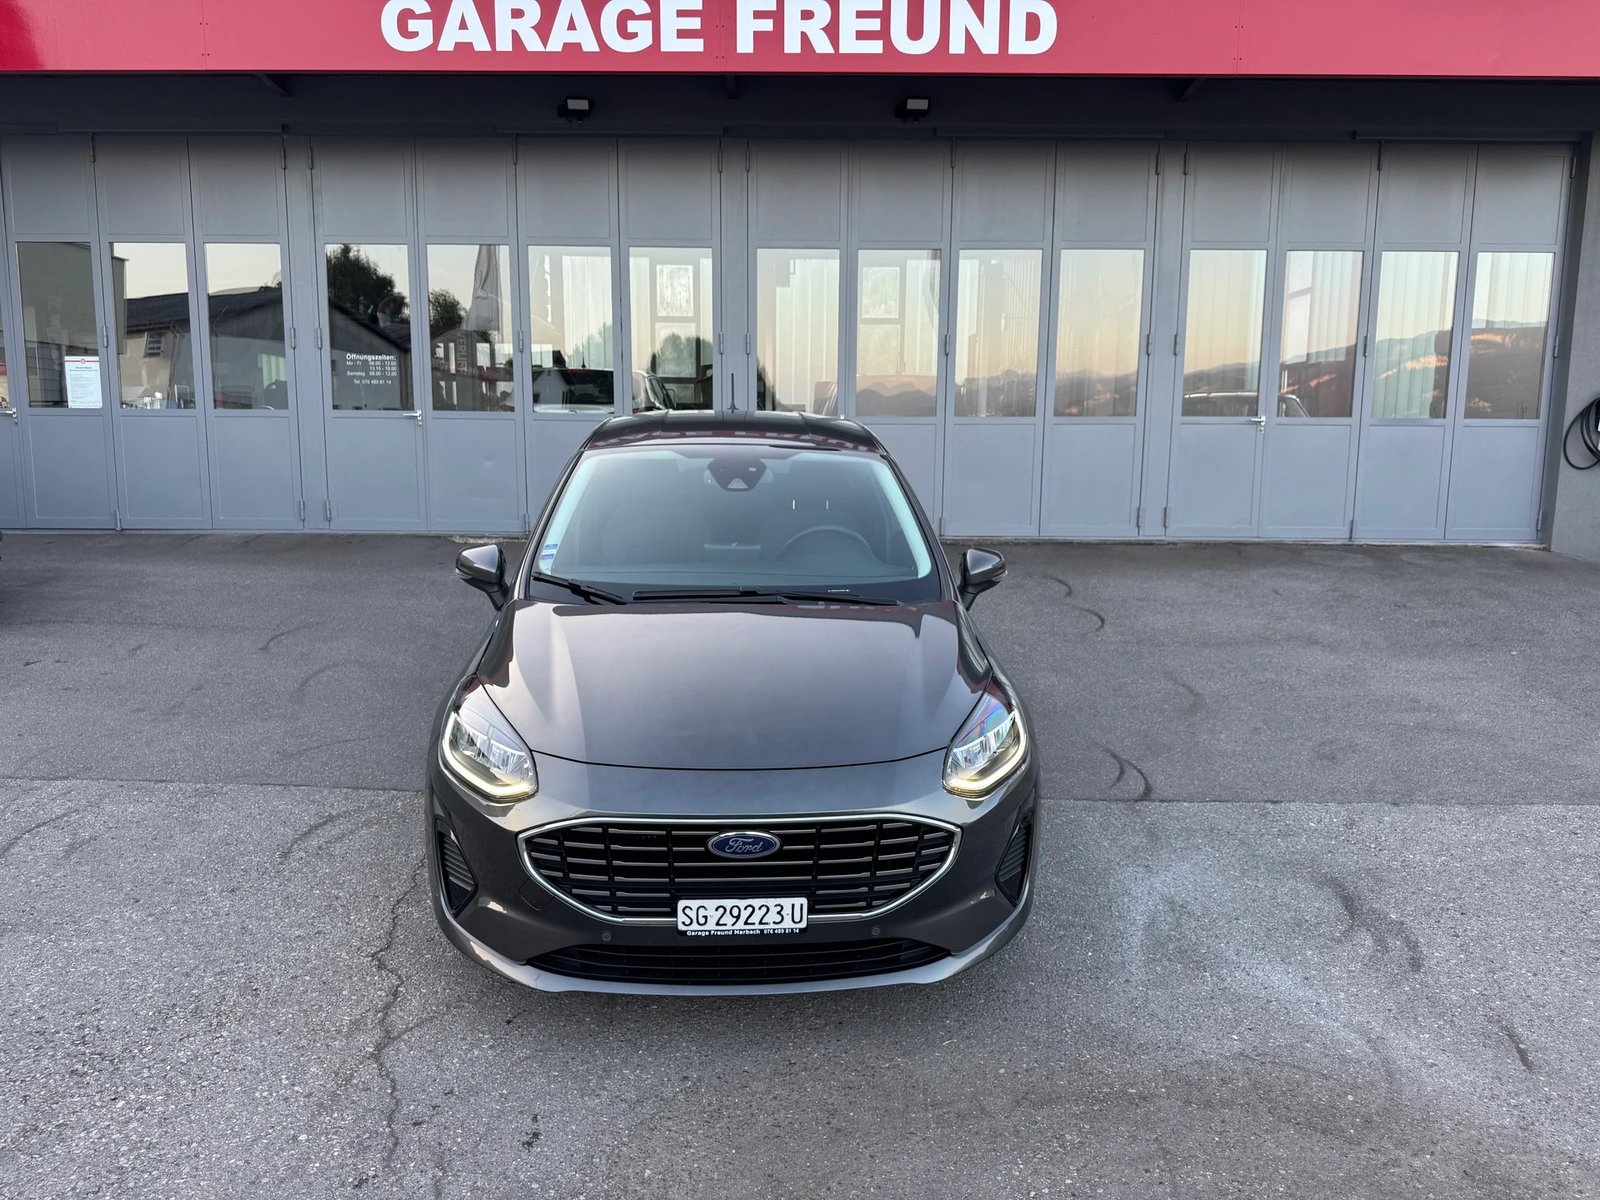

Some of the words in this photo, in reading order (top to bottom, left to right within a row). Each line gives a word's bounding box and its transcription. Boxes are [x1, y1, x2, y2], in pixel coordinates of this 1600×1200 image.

[380, 0, 704, 53] GARAGE
[736, 0, 1057, 55] FREUND
[346, 353, 397, 361] Öffnungszeiten:
[725, 837, 764, 853] Ford
